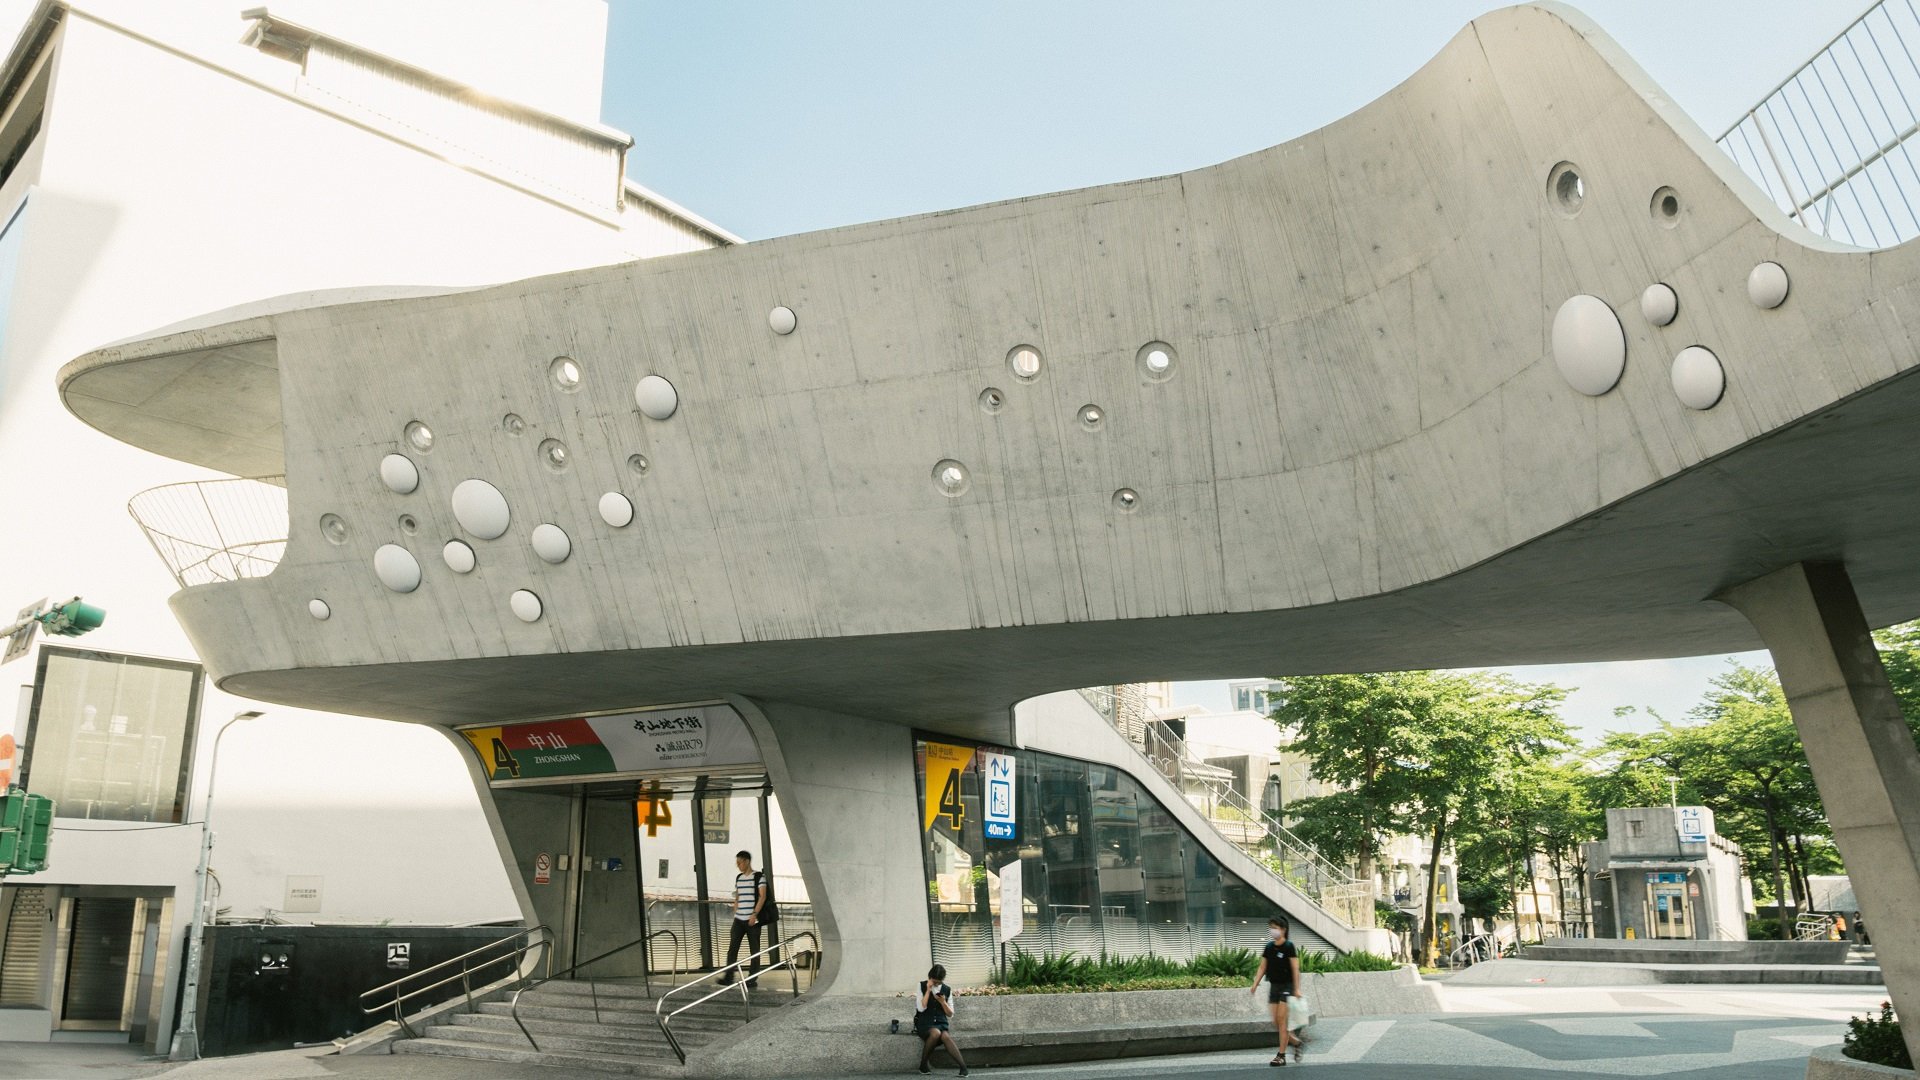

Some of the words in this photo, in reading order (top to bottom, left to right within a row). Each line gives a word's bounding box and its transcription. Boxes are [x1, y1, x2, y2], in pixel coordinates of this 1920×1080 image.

[633, 716, 702, 733] 中山地下街
[527, 732, 567, 751] 中山
[491, 737, 520, 777] 4
[534, 753, 580, 764] ZHONGSHAN
[938, 768, 965, 831] 4
[988, 823, 1004, 836] 40m
